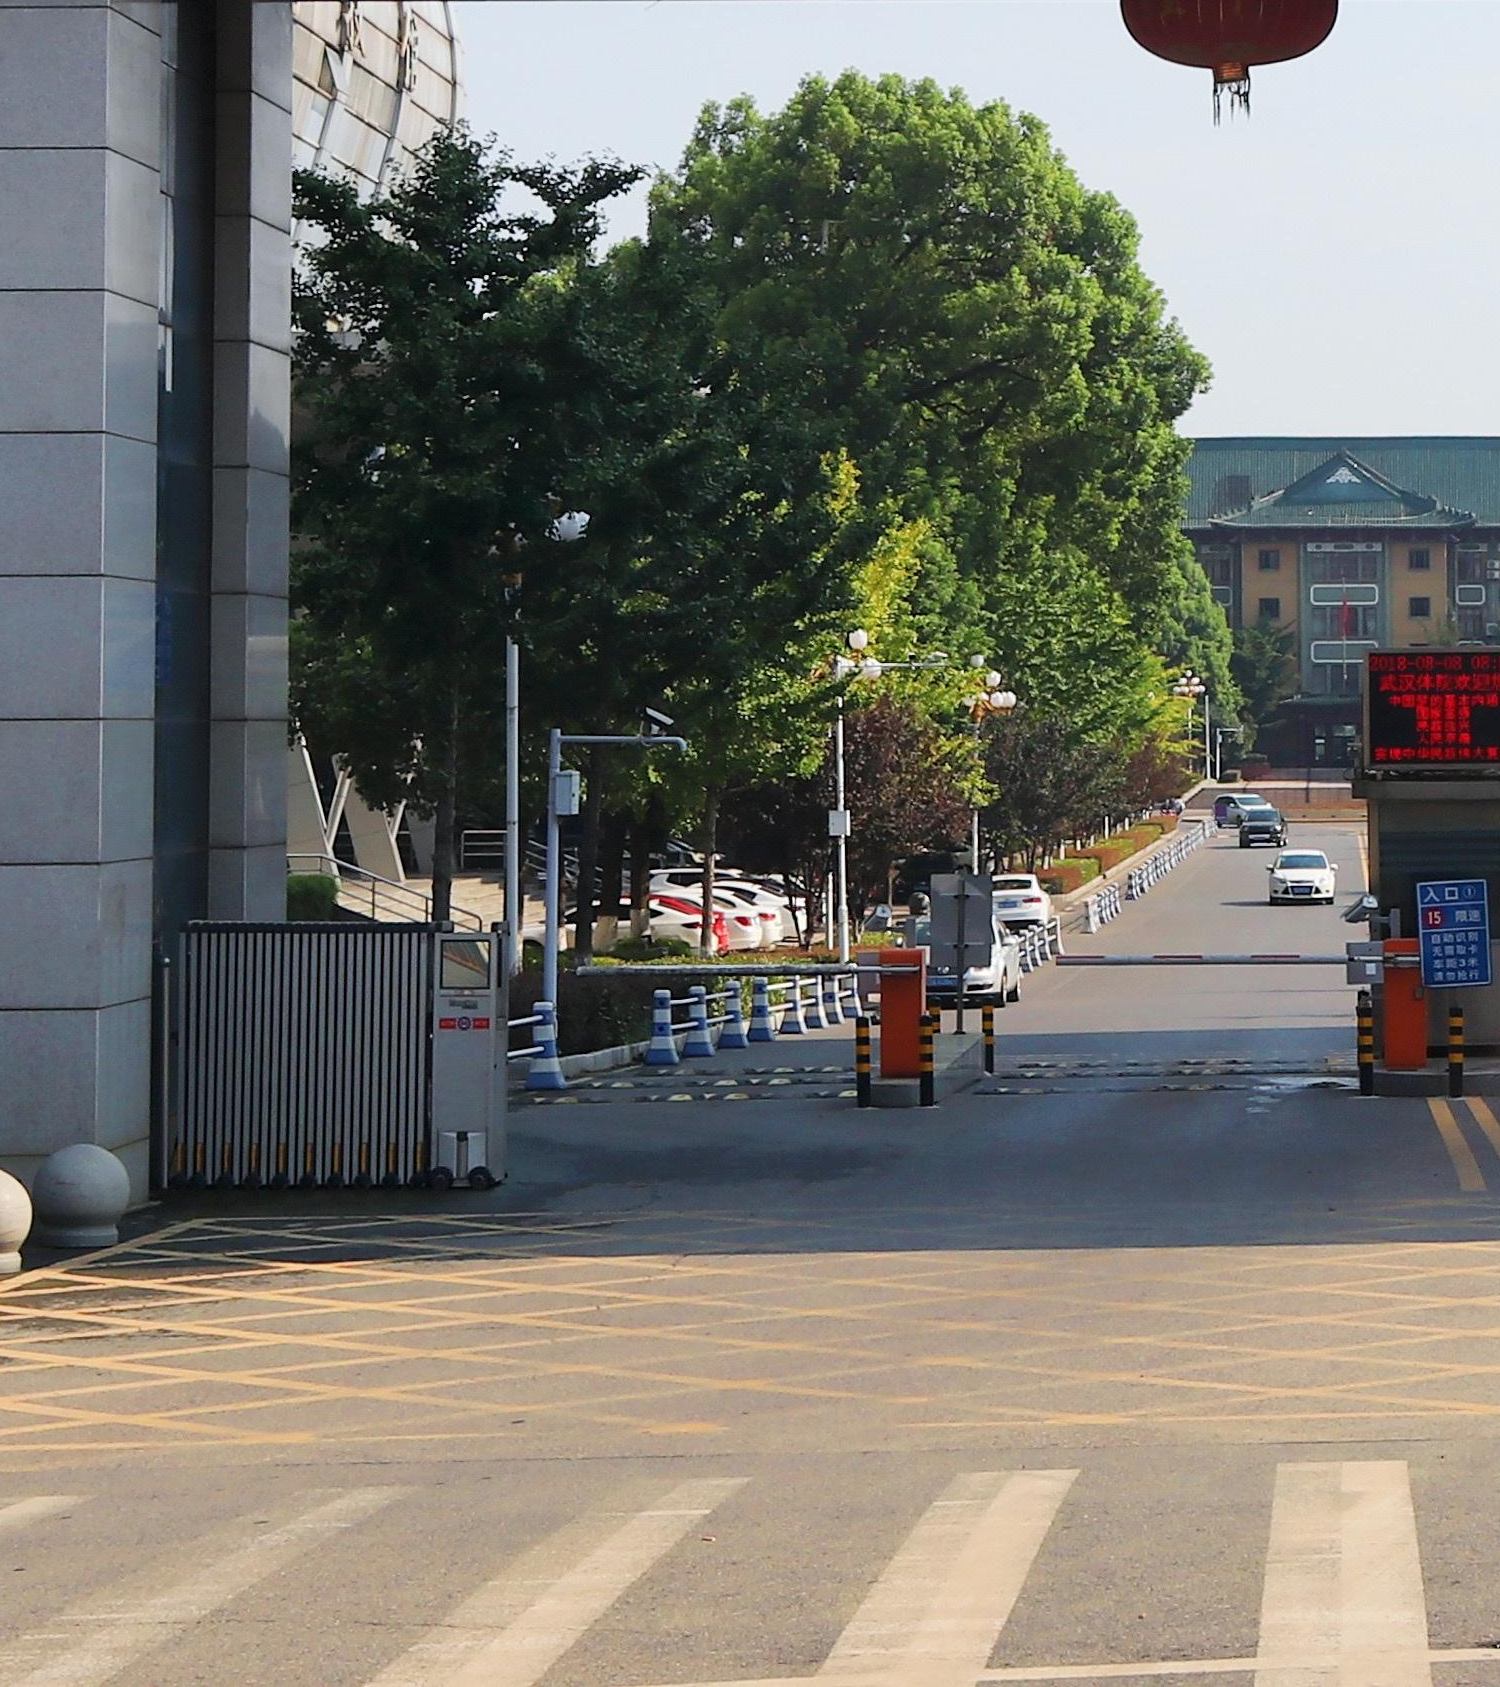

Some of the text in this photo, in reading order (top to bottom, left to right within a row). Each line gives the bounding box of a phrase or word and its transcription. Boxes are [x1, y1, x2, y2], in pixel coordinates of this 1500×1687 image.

[1427, 909, 1481, 925] 15 限速
[1431, 931, 1479, 945] 自动识别
[1432, 944, 1478, 957] 无需取卡
[1433, 957, 1479, 969] 车距3米
